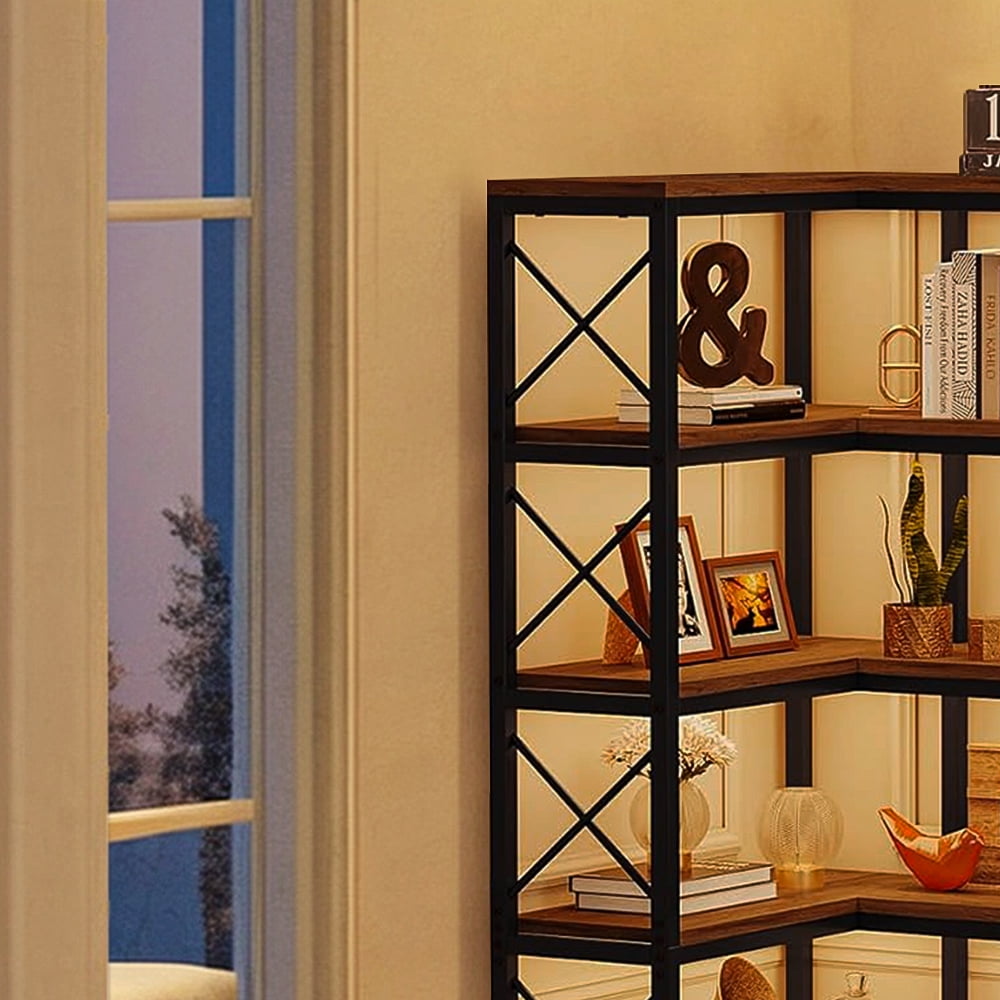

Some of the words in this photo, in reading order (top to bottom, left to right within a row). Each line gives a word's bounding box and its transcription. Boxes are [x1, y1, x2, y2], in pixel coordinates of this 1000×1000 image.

[924, 278, 933, 311] LOST
[957, 291, 968, 328] ZAHA
[985, 295, 996, 330] FRIDA
[957, 331, 968, 375] HADID
[985, 338, 996, 380] KAHLO
